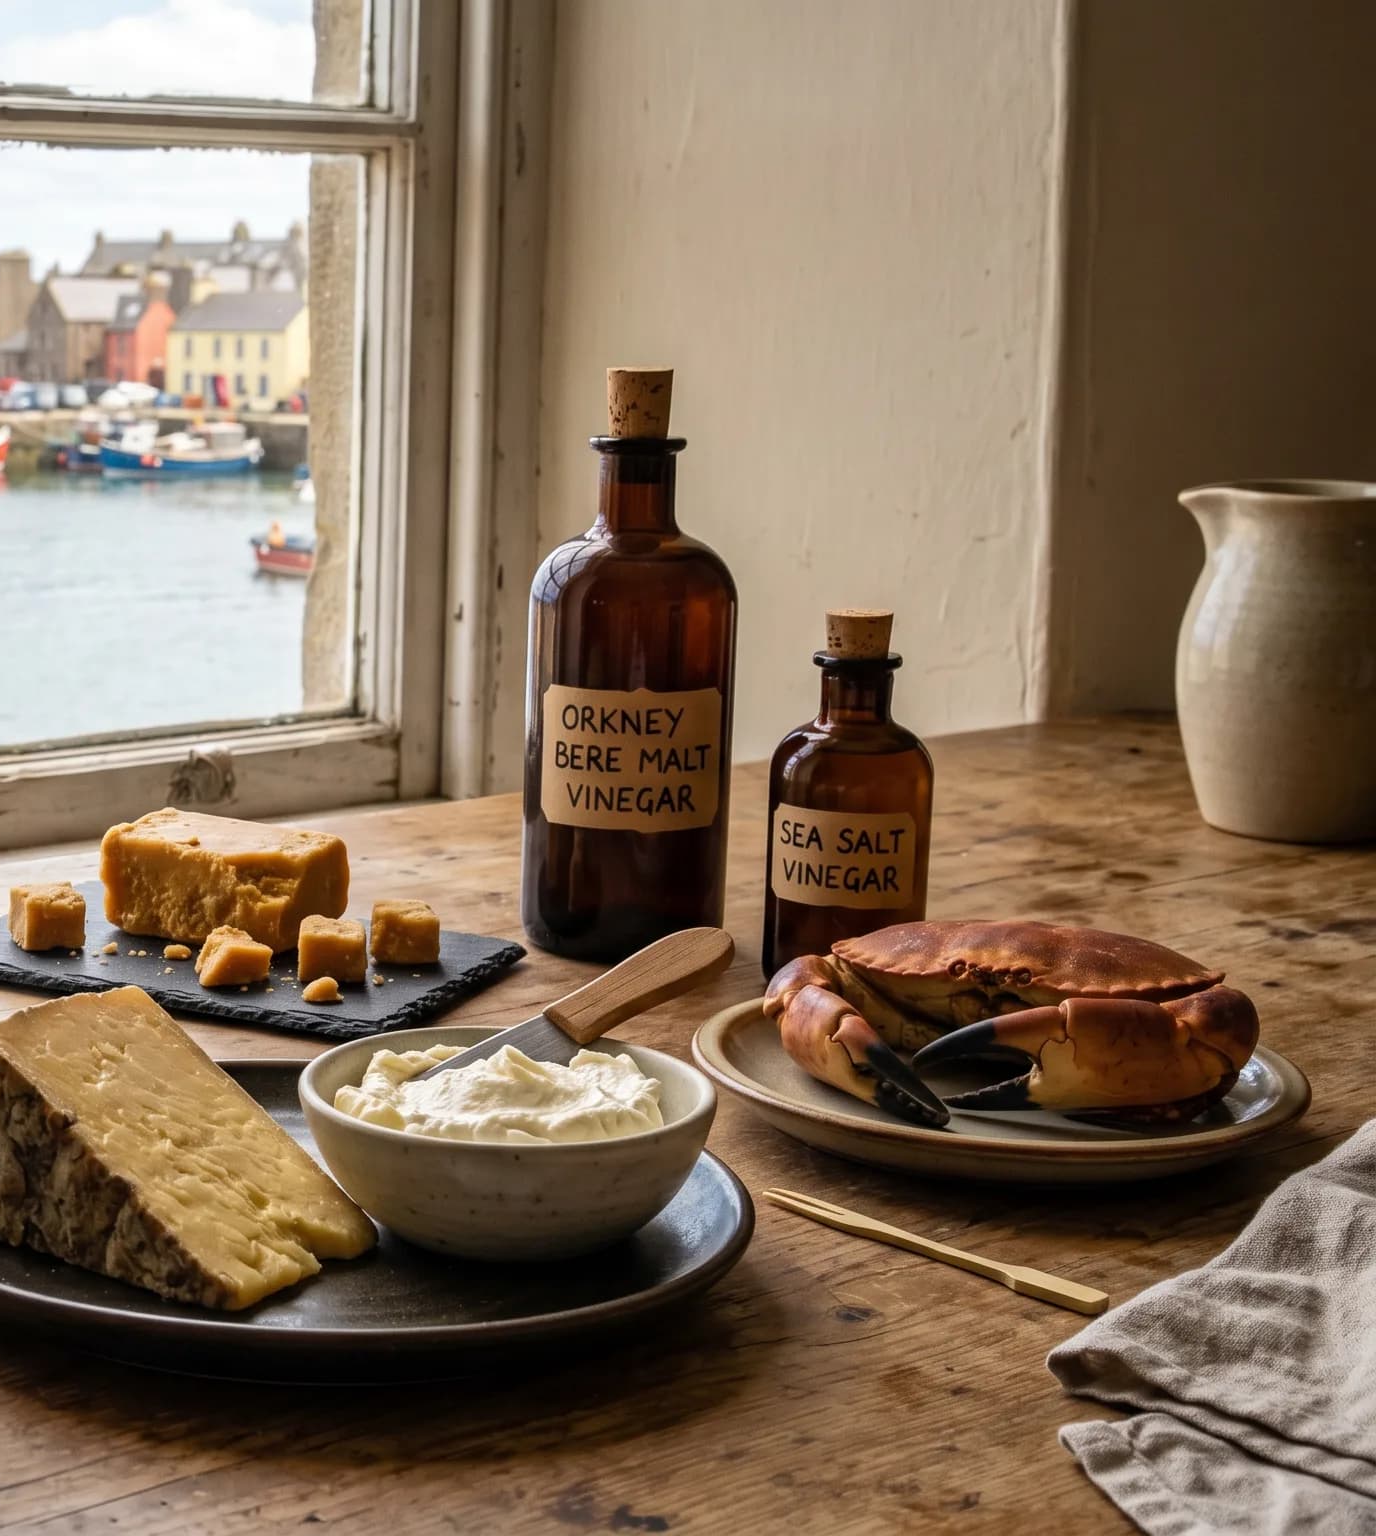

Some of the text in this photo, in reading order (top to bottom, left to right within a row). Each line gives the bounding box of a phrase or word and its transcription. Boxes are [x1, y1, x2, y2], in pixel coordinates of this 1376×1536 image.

[562, 704, 684, 738] ORKNEY
[555, 741, 711, 774] BERE MALT
[566, 782, 696, 816] VINEGAR
[780, 820, 905, 855] SEA SALT
[783, 857, 899, 893] VINEGAR
